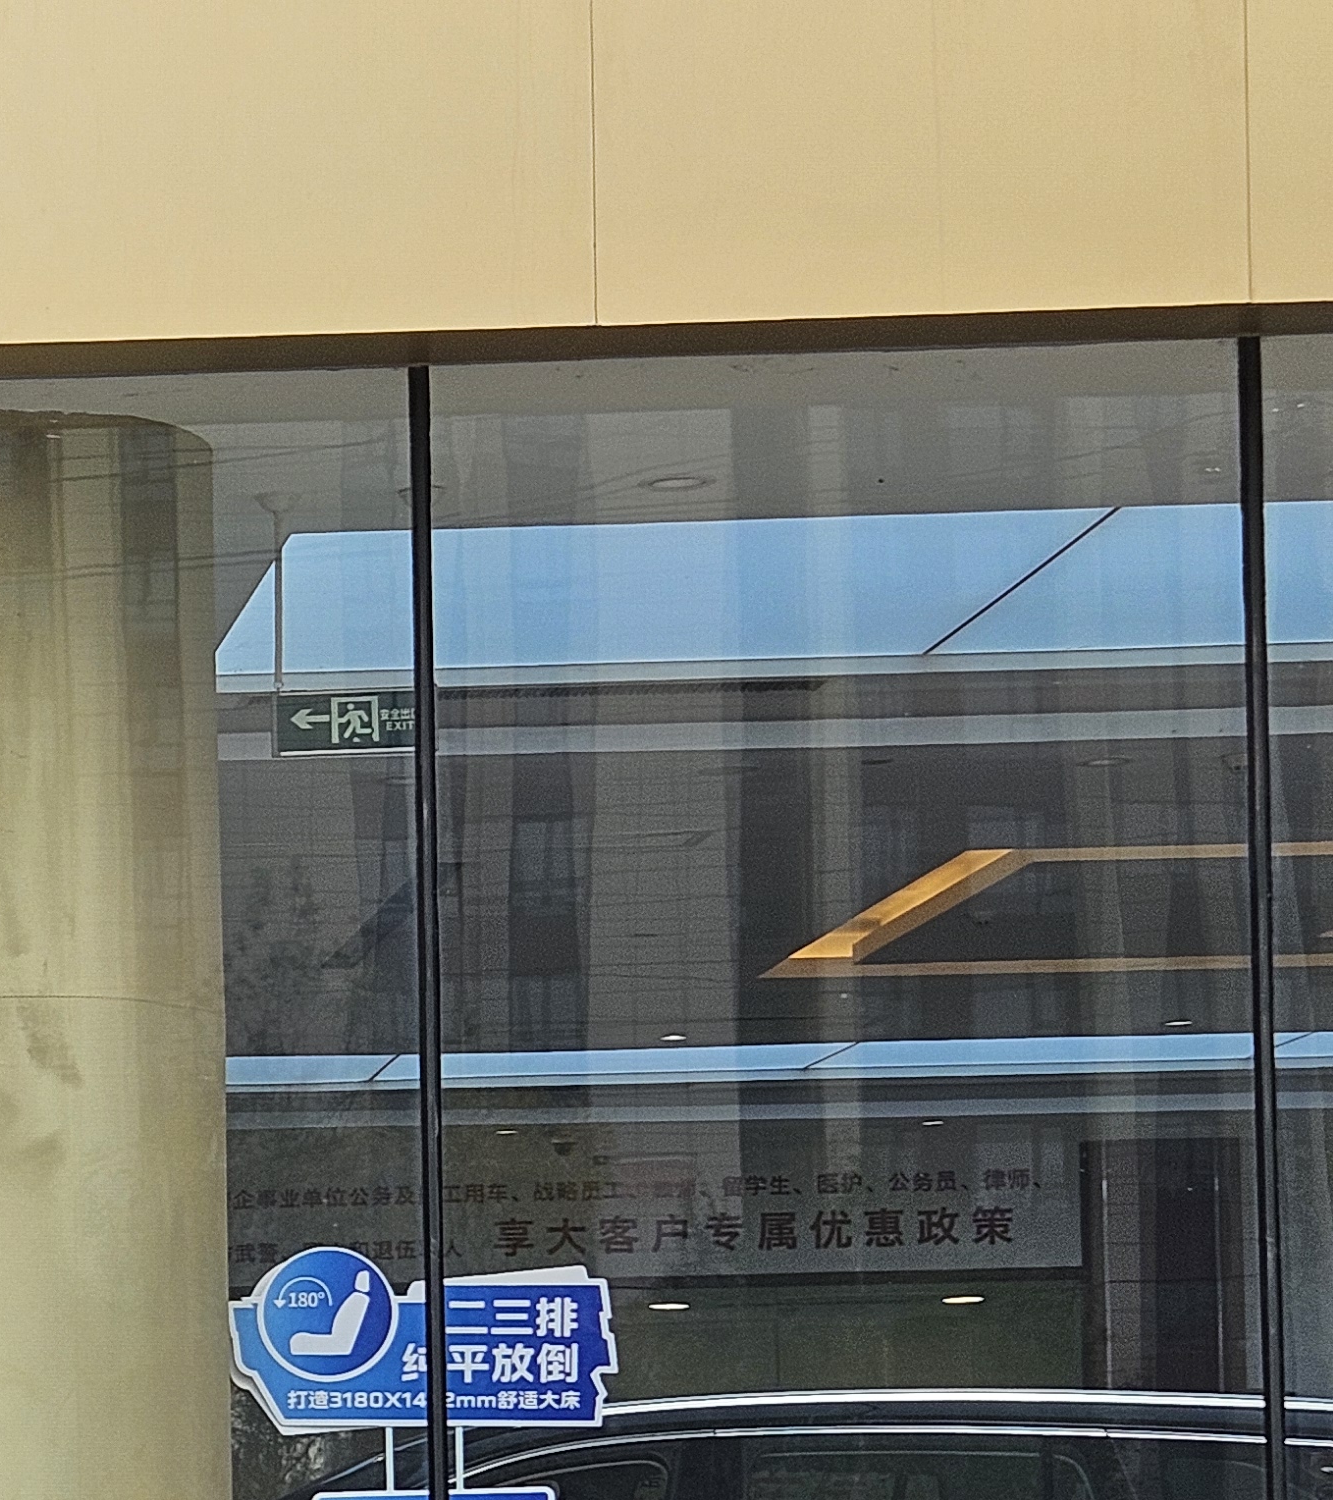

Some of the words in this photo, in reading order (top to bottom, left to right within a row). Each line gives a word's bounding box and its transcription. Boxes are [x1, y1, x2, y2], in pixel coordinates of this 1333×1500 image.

[386, 722, 414, 731] EXIT
[494, 1206, 1013, 1258] 享大客户专属优惠政策
[288, 1291, 325, 1308] 180°
[445, 1297, 579, 1338] 二三排
